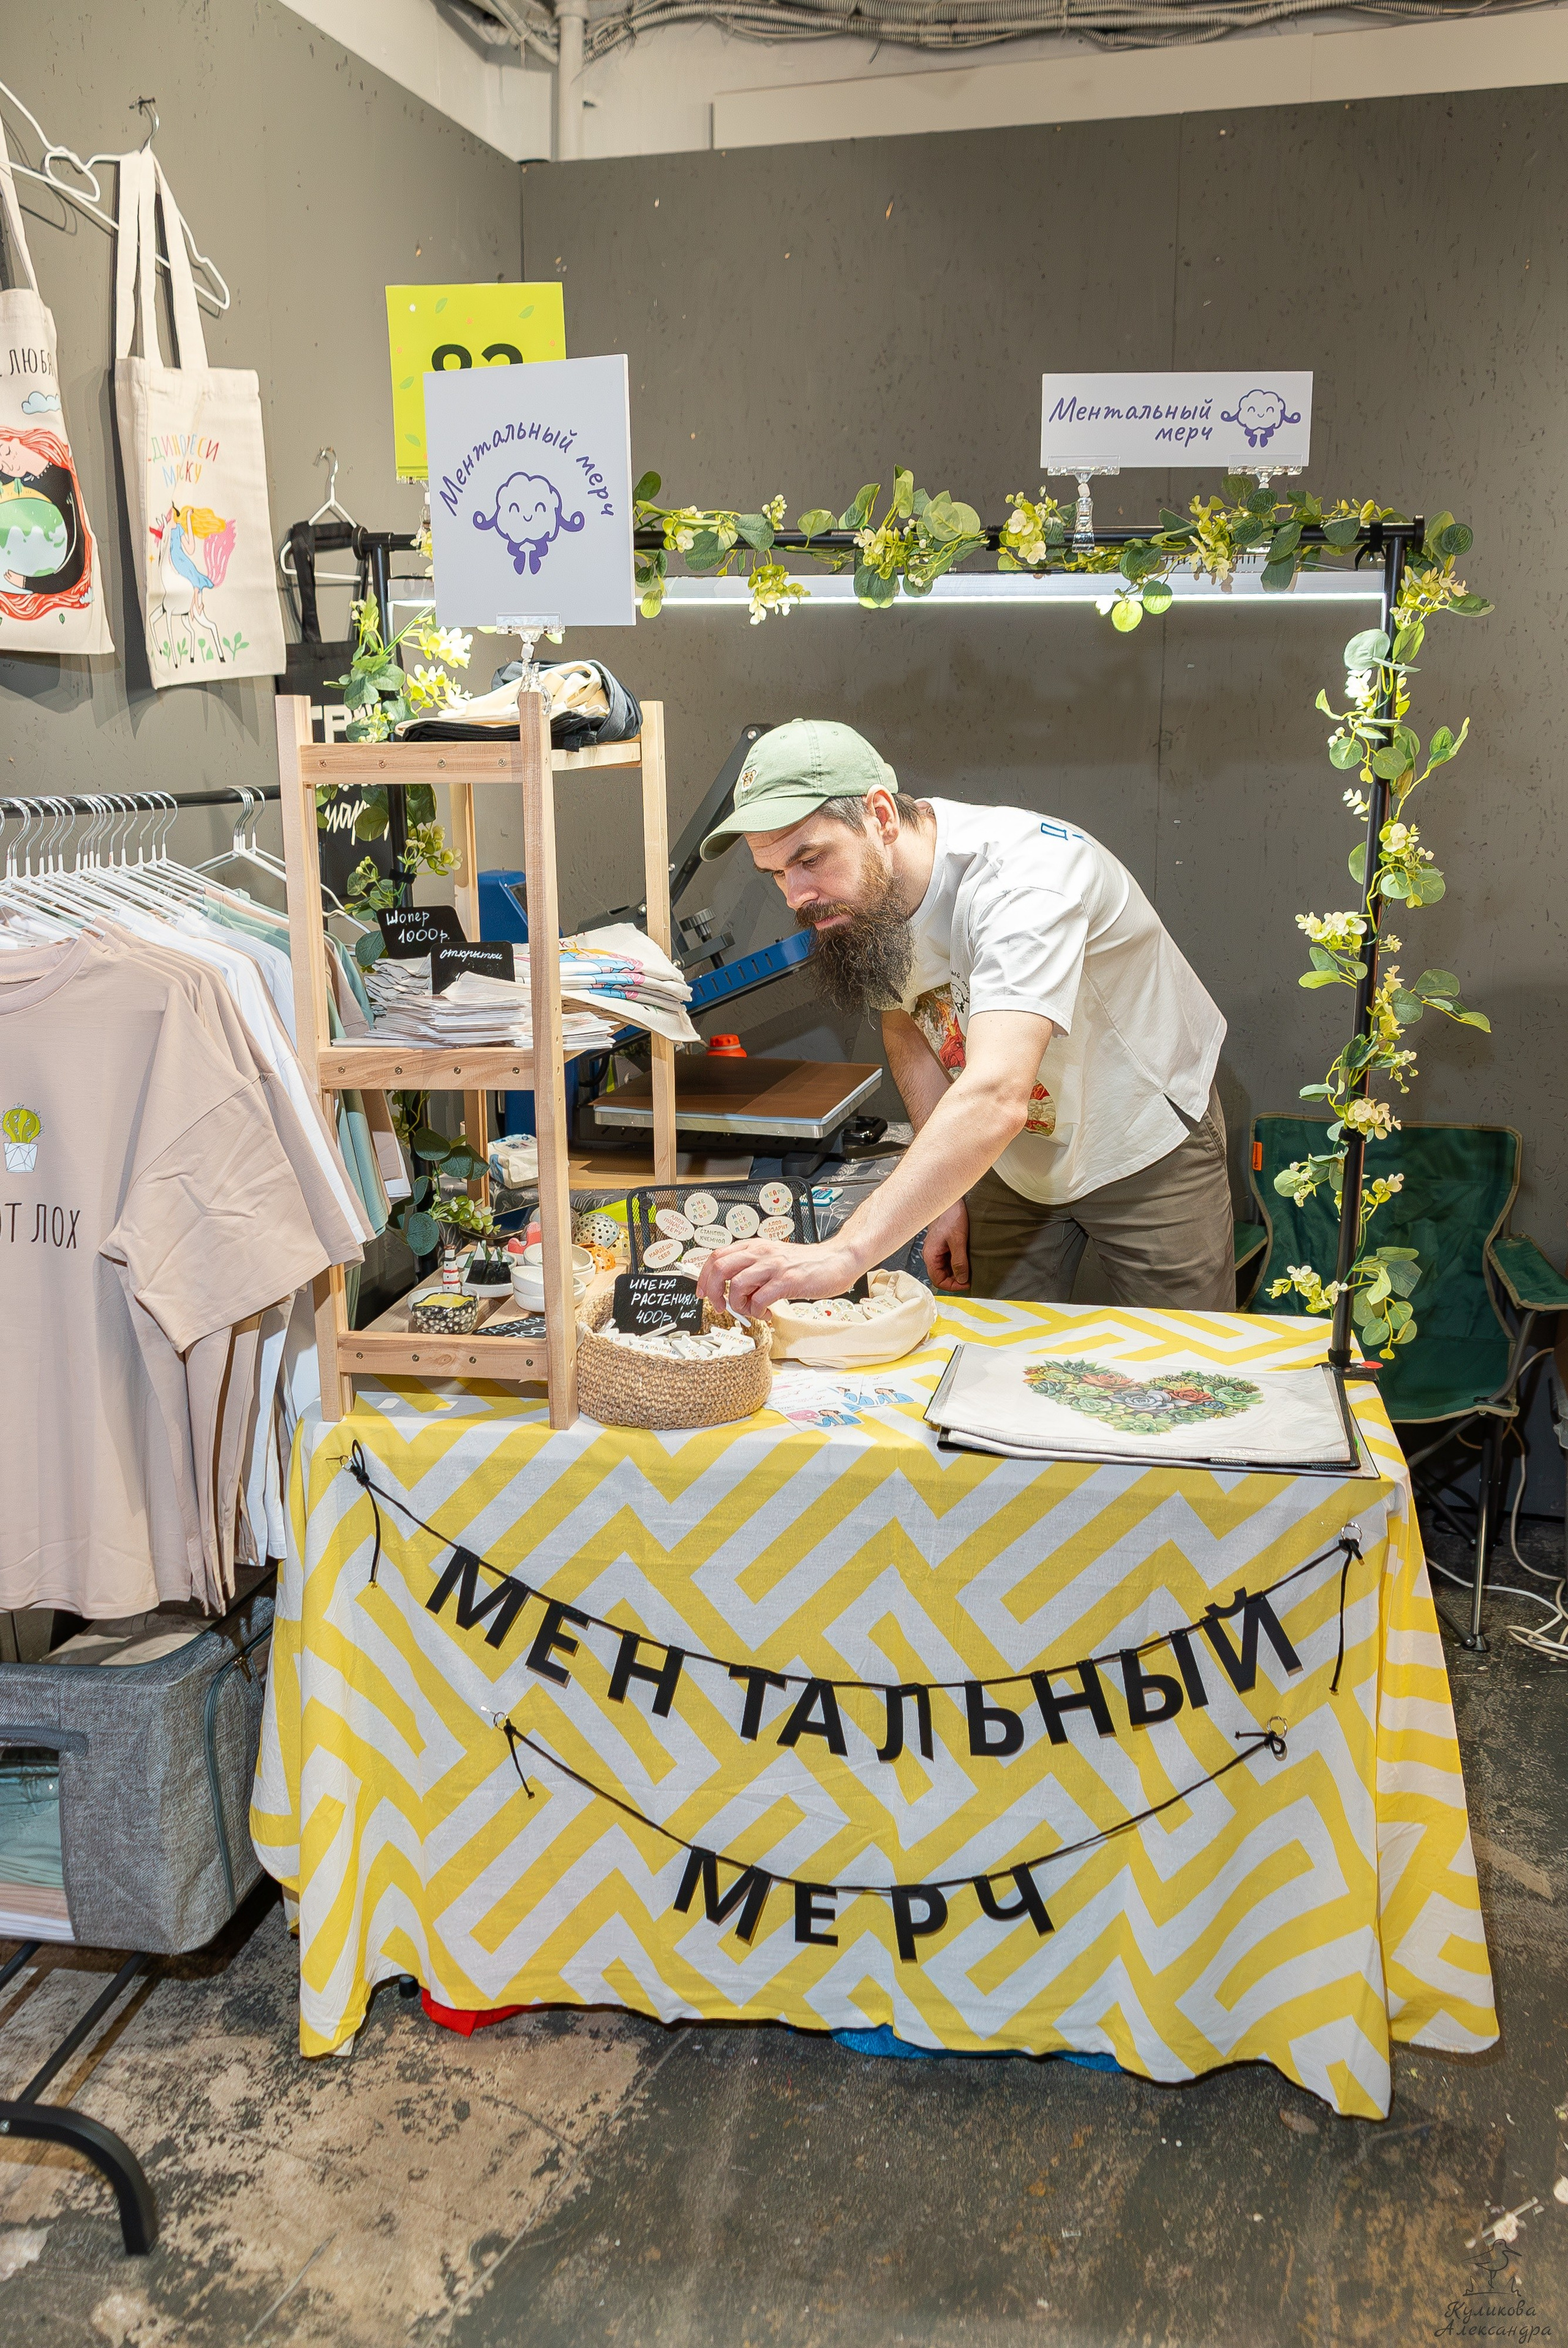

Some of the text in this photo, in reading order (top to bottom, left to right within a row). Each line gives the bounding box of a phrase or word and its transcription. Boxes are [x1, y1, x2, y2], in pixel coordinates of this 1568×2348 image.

[1048, 396, 1214, 423] Ментальный
[1154, 426, 1213, 448] мерч
[439, 421, 614, 516] Ментальный мерч
[386, 910, 430, 926] Шопер
[398, 928, 451, 943] 1000р.
[440, 949, 503, 962] открытки
[0, 1202, 80, 1249] Т ЛОХ
[629, 1278, 677, 1291] ИМЕНА
[630, 1292, 699, 1307] РАСТЕНИЯМ
[674, 1845, 1055, 1964] МЕРЧ
